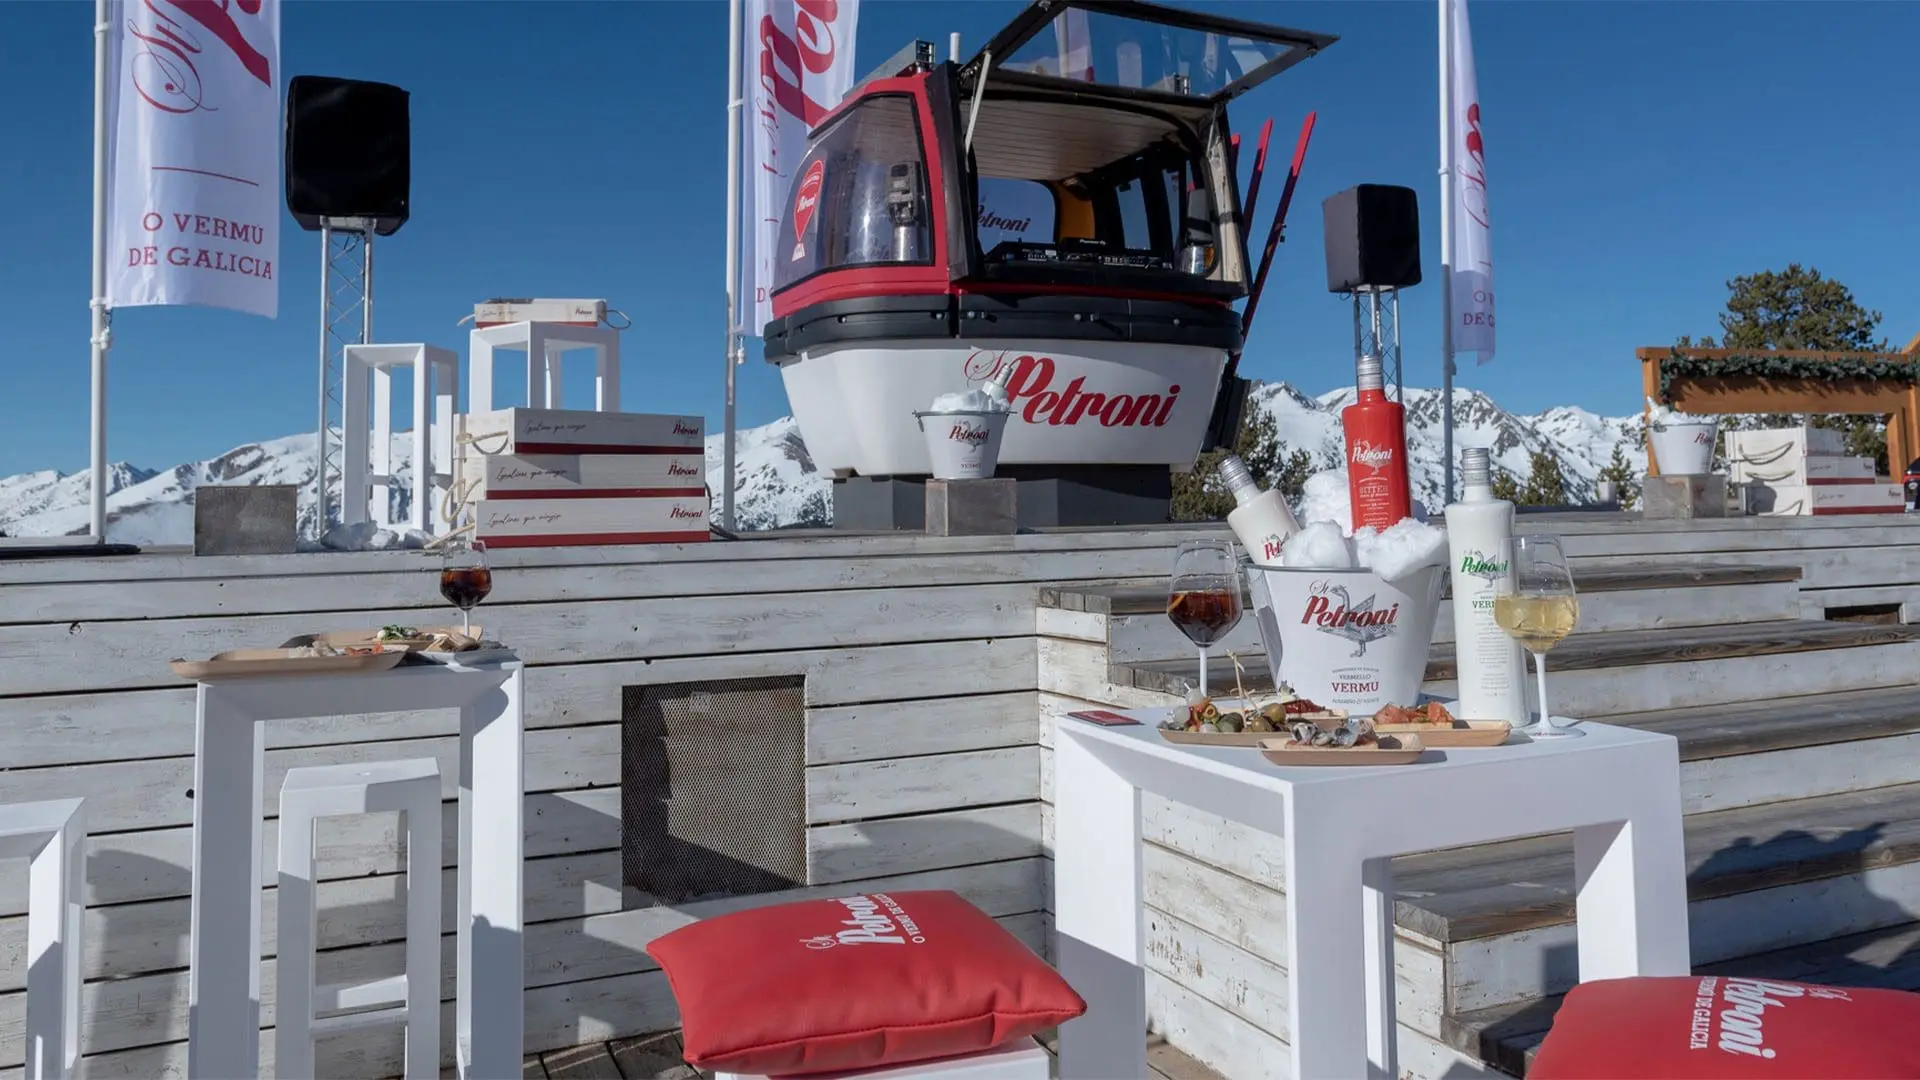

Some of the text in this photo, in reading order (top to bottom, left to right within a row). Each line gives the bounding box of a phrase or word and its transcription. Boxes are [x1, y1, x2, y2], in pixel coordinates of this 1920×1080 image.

[143, 212, 163, 231] O
[128, 246, 272, 280] DE GALICIA
[1463, 311, 1485, 326] DE
[1004, 354, 1181, 428] Petroni
[949, 425, 990, 440] Petroni
[1352, 446, 1393, 463] Petroni
[1461, 556, 1508, 573] Petroni
[1301, 595, 1399, 628] Petroni
[1690, 1008, 1711, 1050] GALICIA
[1718, 976, 1805, 1059] Petroni
